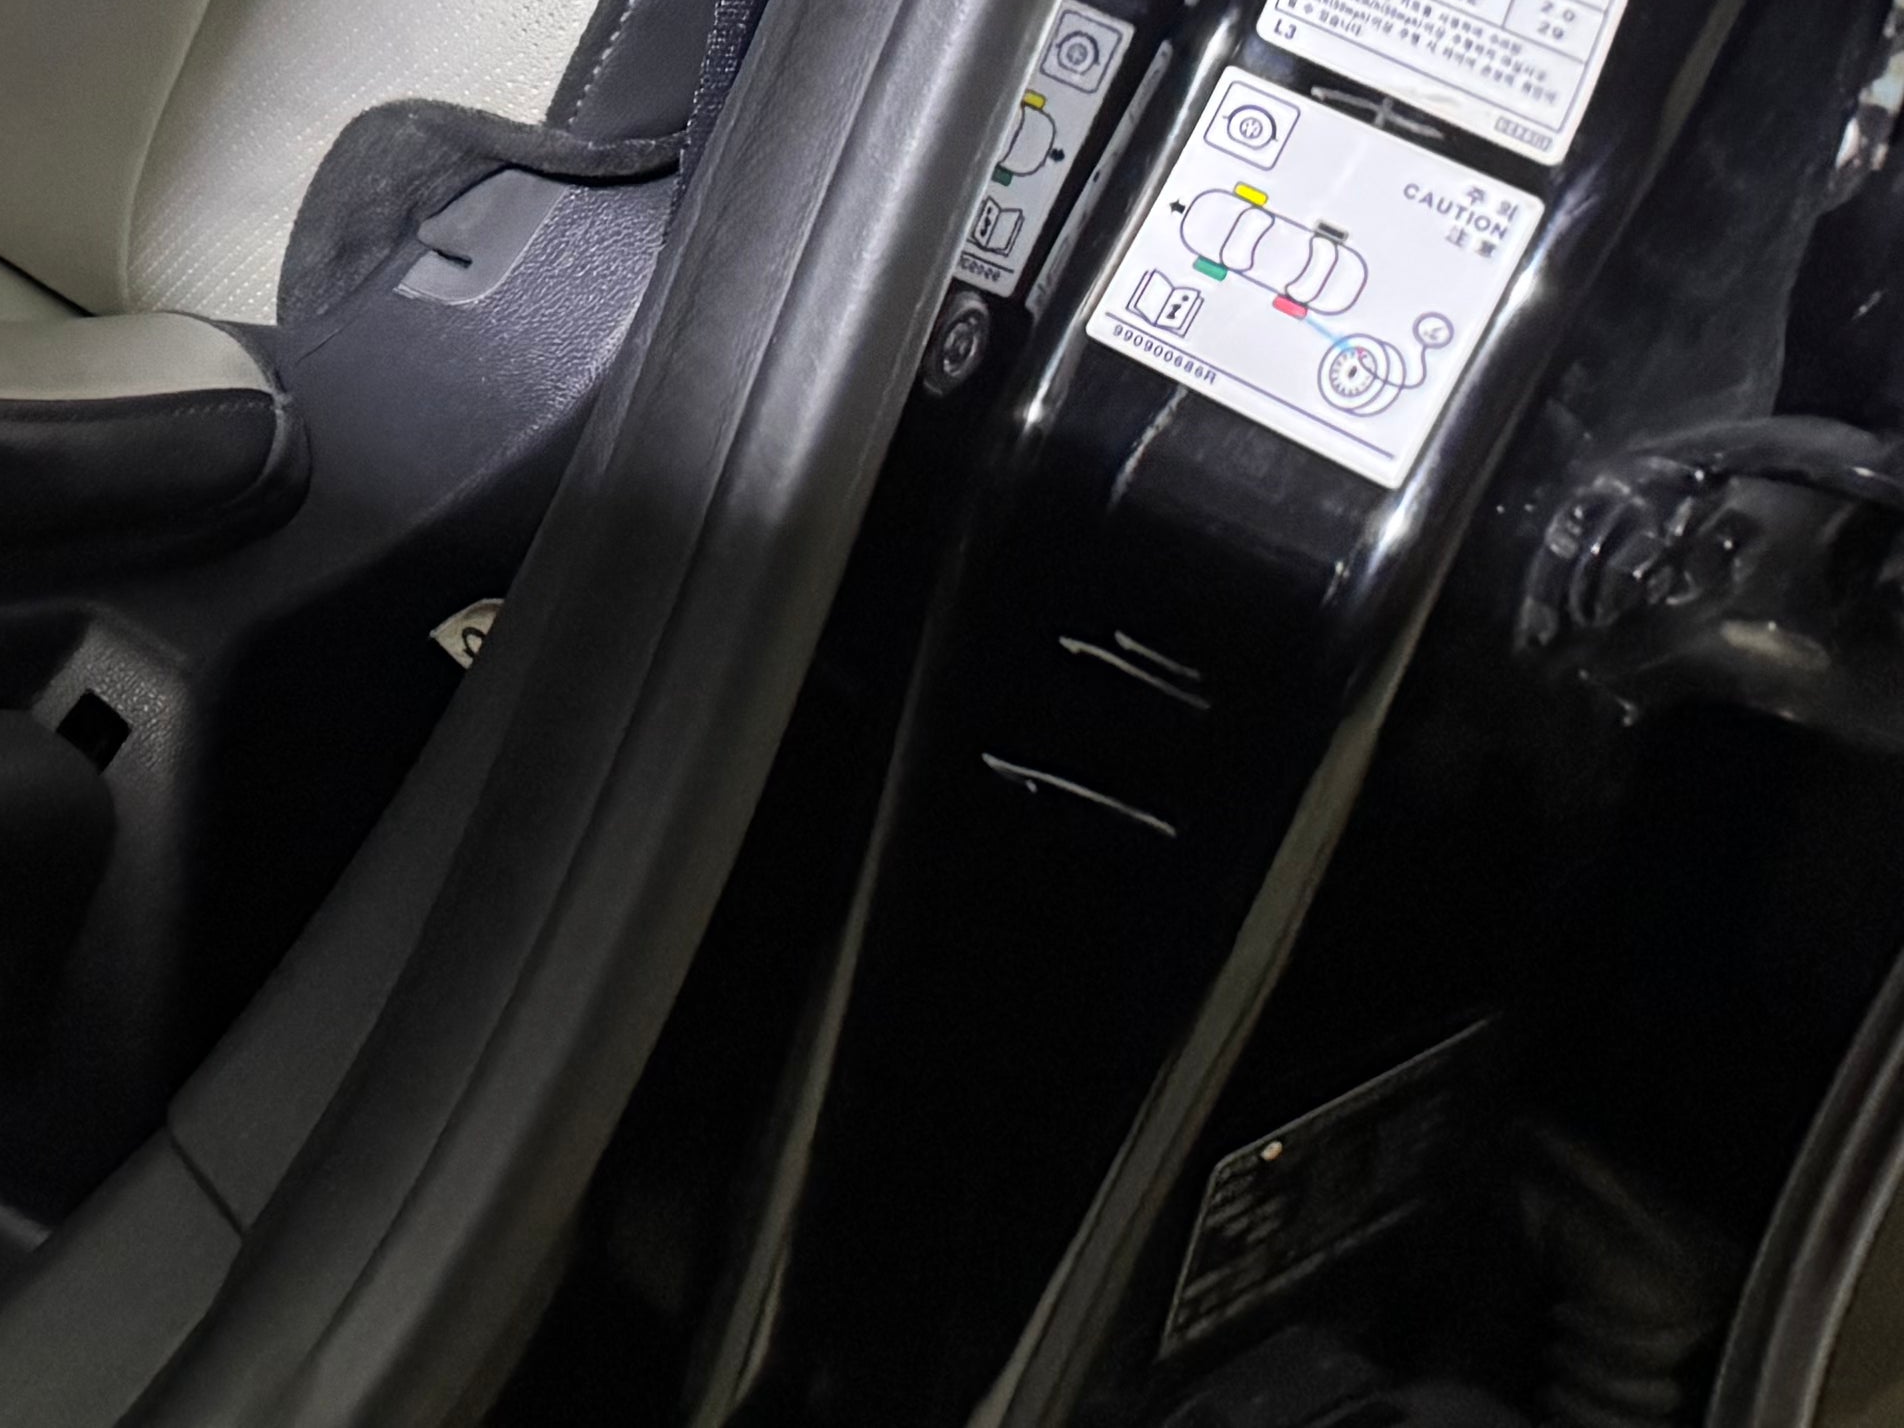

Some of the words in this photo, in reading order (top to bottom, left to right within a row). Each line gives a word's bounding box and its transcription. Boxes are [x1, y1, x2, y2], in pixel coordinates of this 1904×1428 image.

[1273, 19, 1298, 40] L3
[1537, 21, 1565, 40] 29
[1401, 180, 1508, 244] CAUTION
